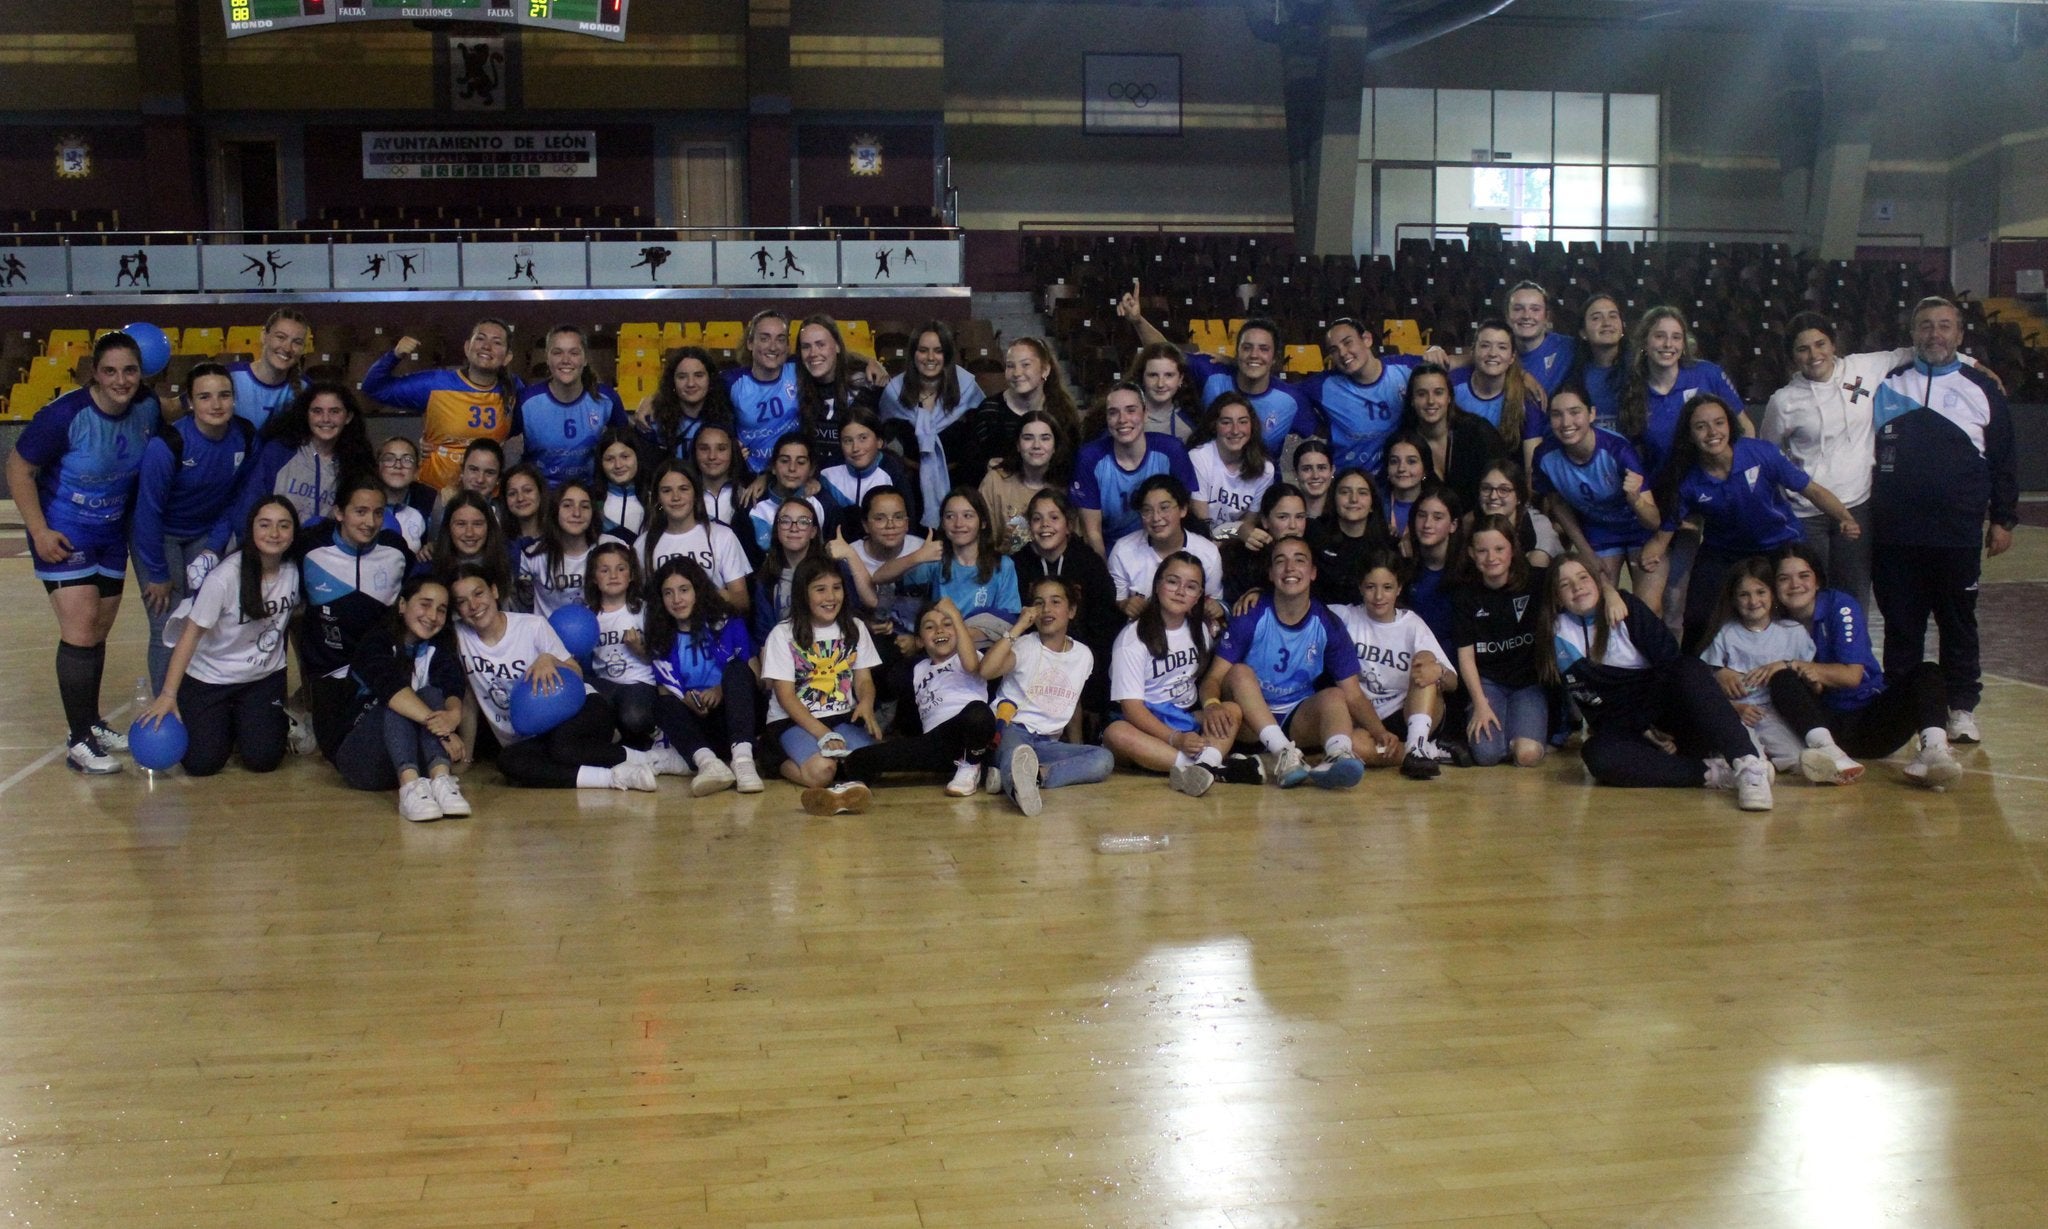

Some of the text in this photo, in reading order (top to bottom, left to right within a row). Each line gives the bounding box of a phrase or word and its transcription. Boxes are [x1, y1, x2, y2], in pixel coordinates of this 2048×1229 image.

[232, 7, 250, 21] 88
[339, 8, 366, 16] FALTAS
[402, 8, 453, 17] EXCLUSIONES
[487, 8, 514, 17] FALTAS
[530, 4, 548, 17] 27
[231, 20, 273, 30] MONDO
[579, 22, 620, 33] MONDO
[373, 133, 586, 150] AYUNTAMIENTO DE LEÓN
[467, 405, 496, 429] 33
[756, 396, 784, 424] 20
[1365, 401, 1391, 420] 18
[563, 418, 577, 439] 6
[116, 434, 129, 459] 2
[1579, 482, 1595, 503] 9
[1487, 632, 1534, 653] OVIEDO
[1152, 647, 1199, 679] LOBA
[1273, 647, 1290, 673] 3
[1357, 642, 1411, 672] OBAS
[462, 655, 526, 680] LOBAS
[1029, 684, 1078, 701] STRAWBERRY
